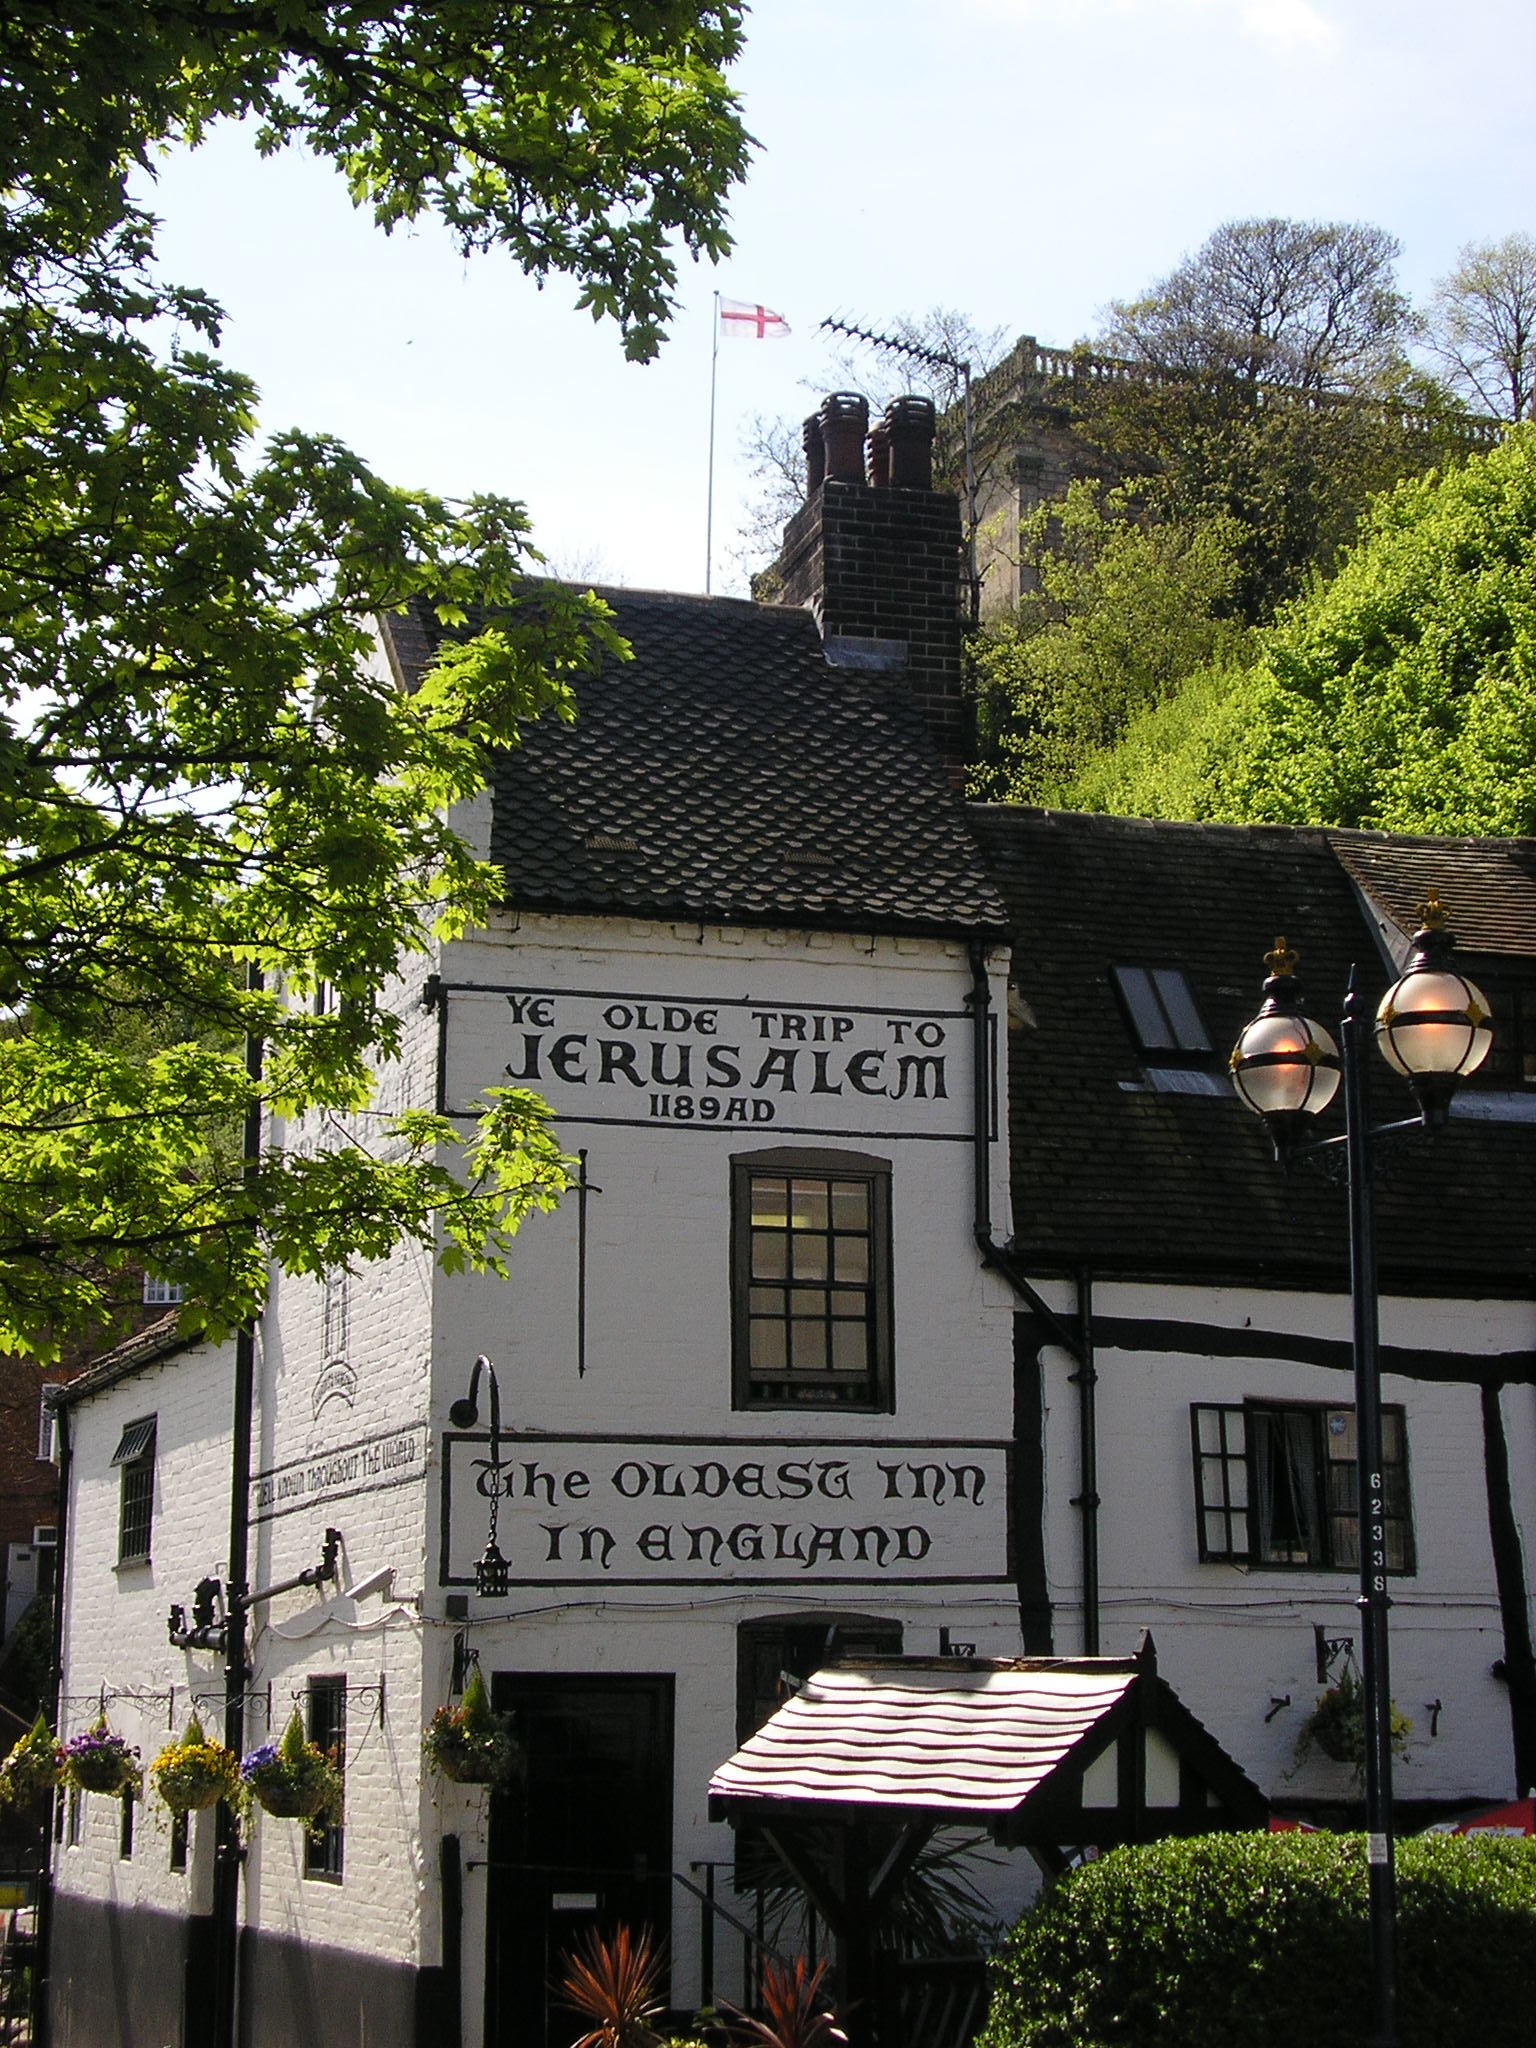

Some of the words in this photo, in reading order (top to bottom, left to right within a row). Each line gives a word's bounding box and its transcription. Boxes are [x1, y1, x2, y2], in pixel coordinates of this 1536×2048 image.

[602, 1004, 719, 1035] OLDE
[752, 1012, 855, 1042] TRIP
[887, 1020, 946, 1048] TO
[504, 1032, 950, 1100] JERUSALEM
